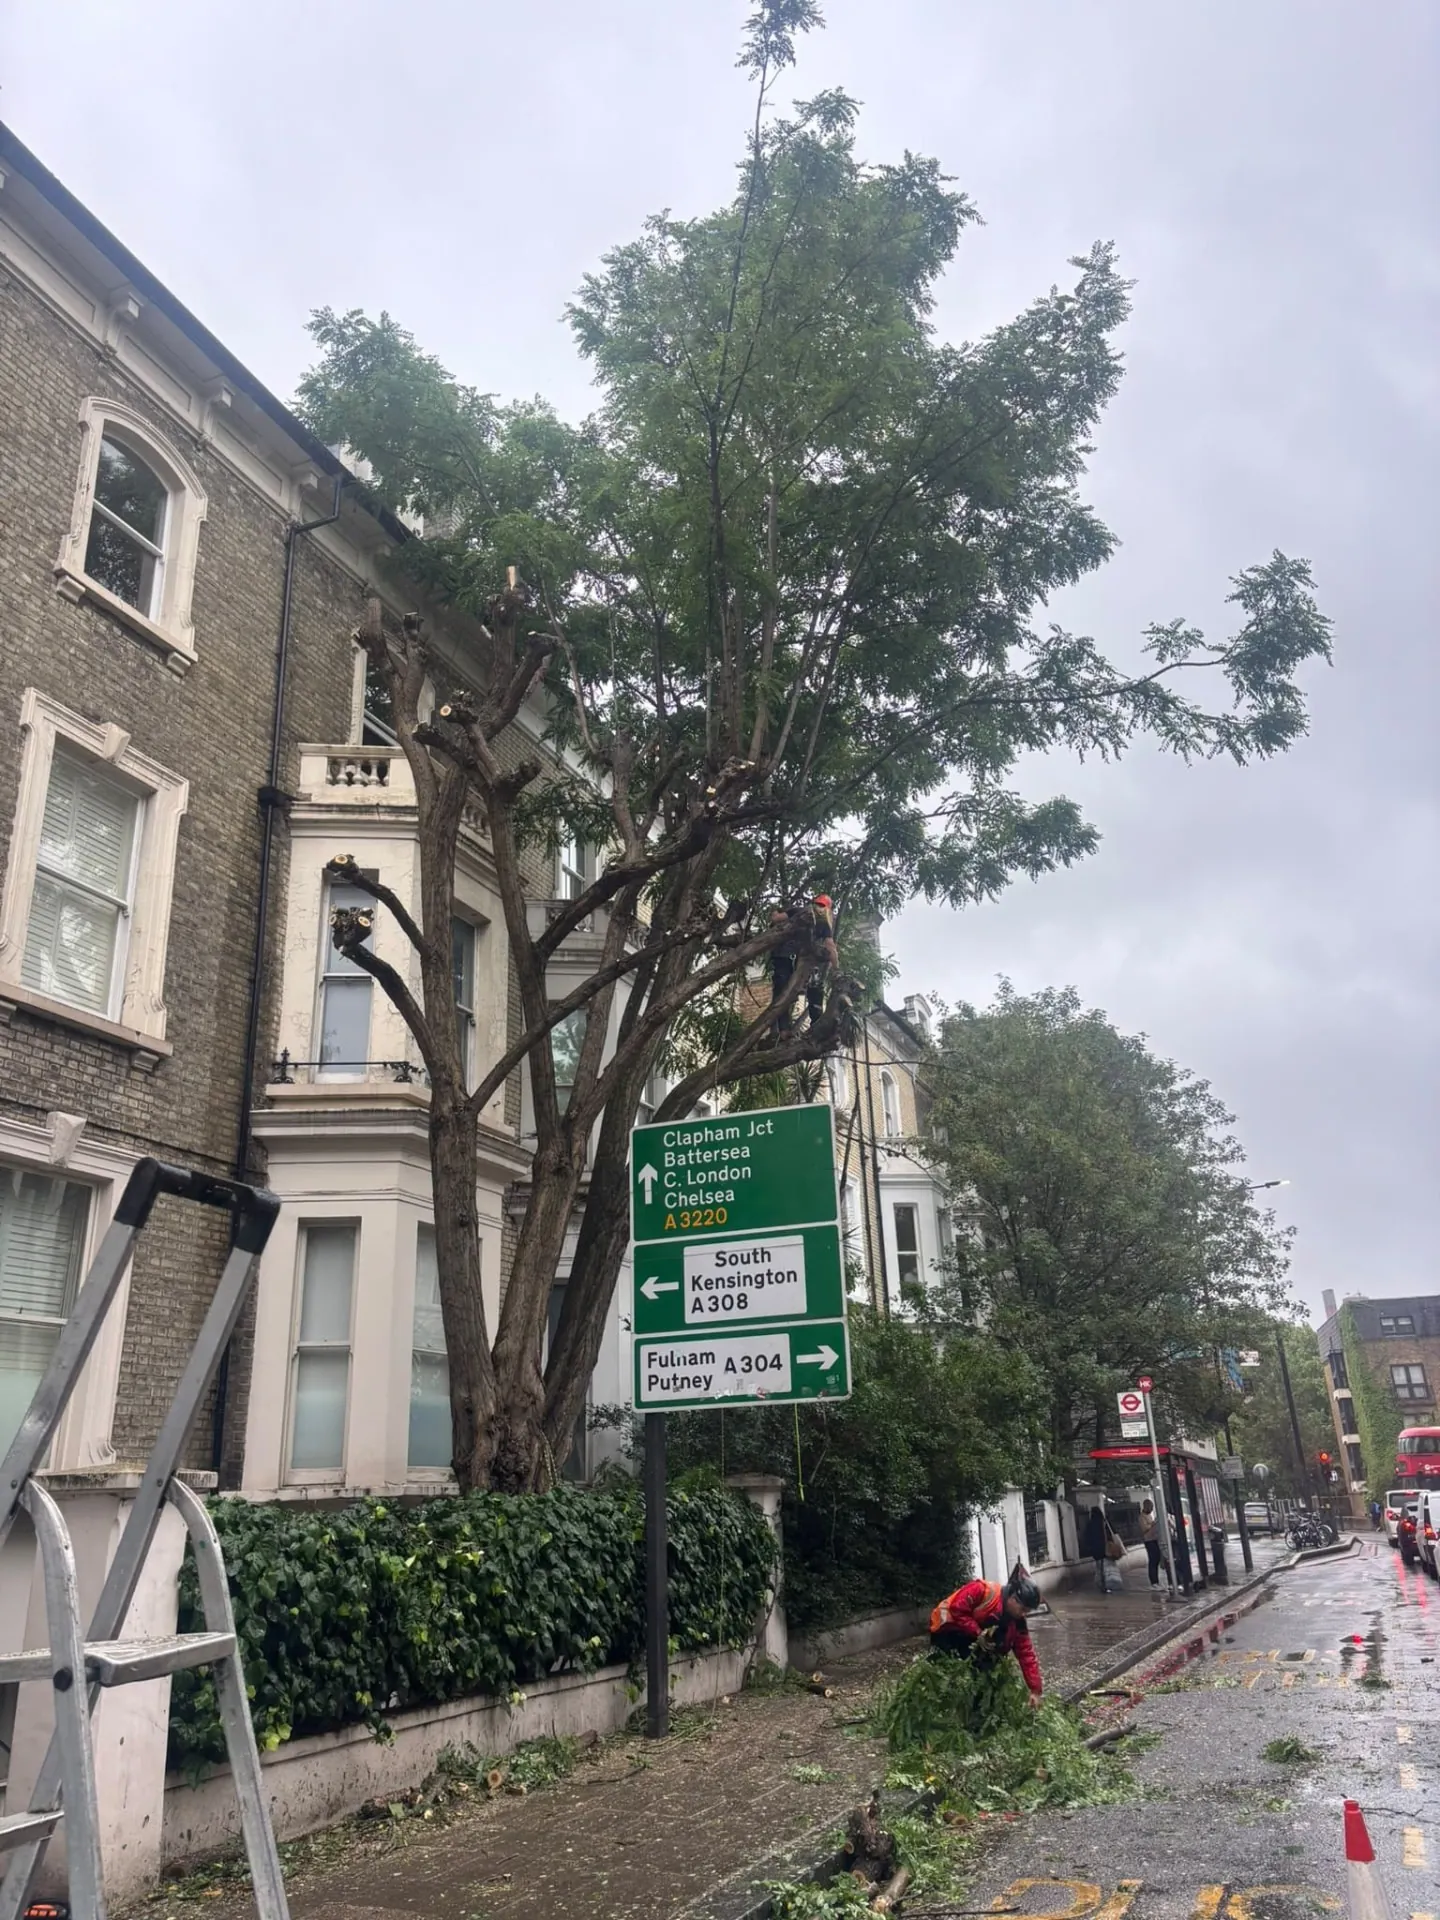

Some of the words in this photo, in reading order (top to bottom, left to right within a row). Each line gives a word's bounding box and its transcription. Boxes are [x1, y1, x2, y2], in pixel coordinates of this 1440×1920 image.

[663, 1125, 740, 1148] Clapham
[747, 1118, 774, 1137] Jct
[664, 1144, 751, 1167] Battersea
[664, 1171, 682, 1188] C.
[687, 1165, 751, 1185] London
[664, 1189, 735, 1208] Chelsea
[664, 1207, 727, 1230] A3220
[715, 1247, 772, 1267] South
[691, 1269, 798, 1294] Kensington
[691, 1294, 749, 1314] A308
[724, 1353, 783, 1374] A304
[647, 1373, 713, 1392] Putney
